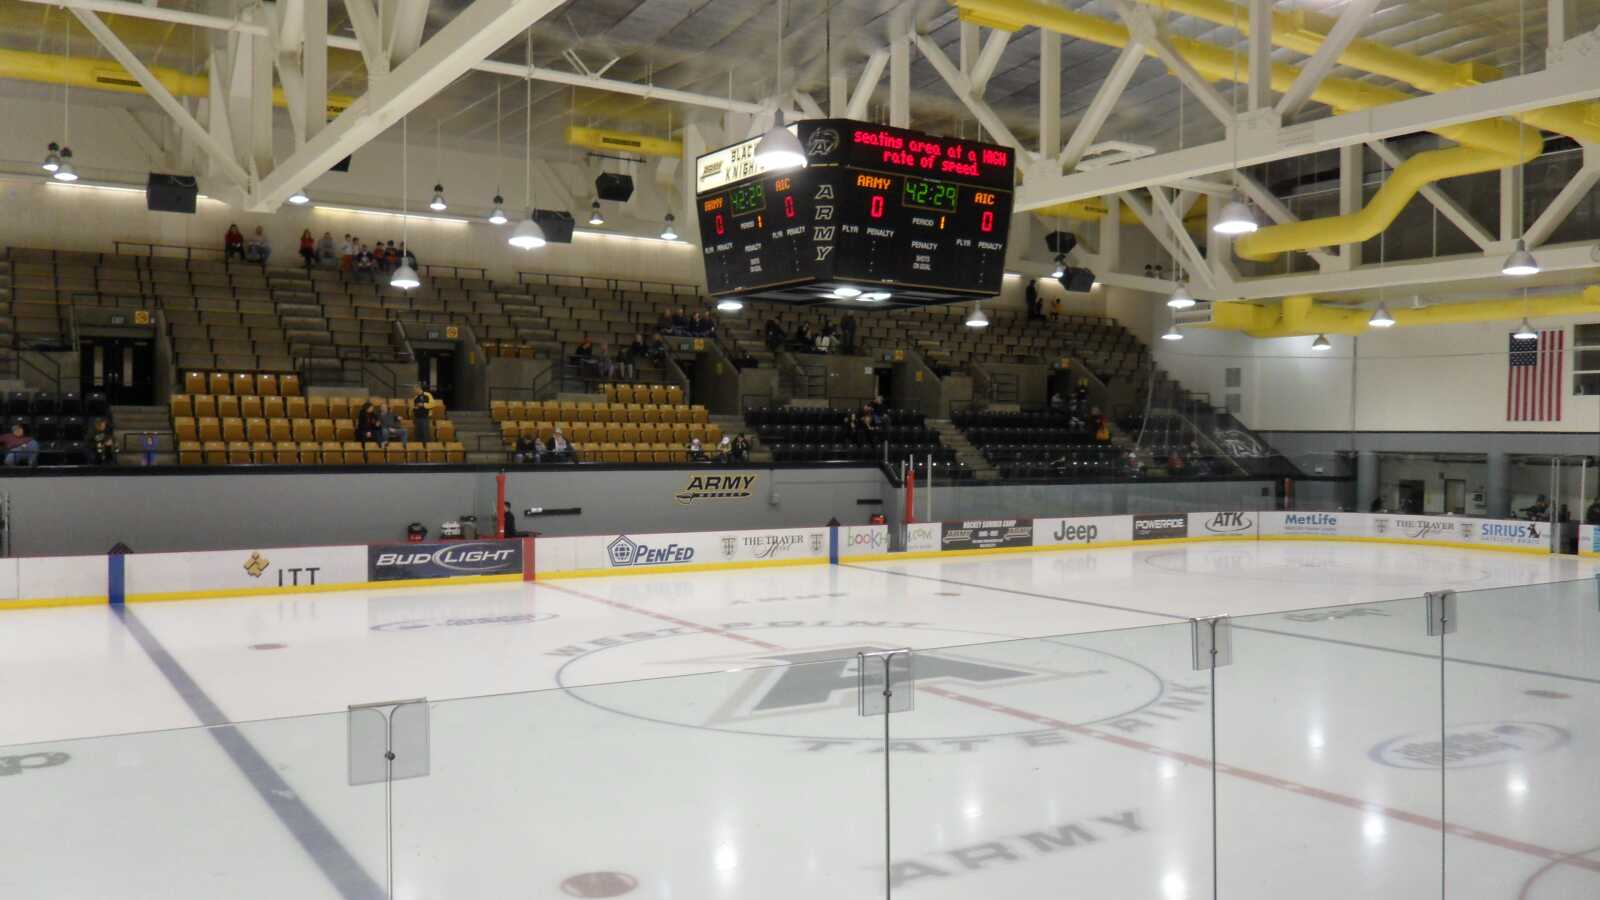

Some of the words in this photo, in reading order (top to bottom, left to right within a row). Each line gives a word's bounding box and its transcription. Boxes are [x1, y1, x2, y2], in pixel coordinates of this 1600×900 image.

[731, 145, 753, 162] BLAC
[883, 150, 914, 167] rate
[919, 155, 935, 169] of
[908, 140, 941, 156] area
[947, 144, 962, 160] at
[968, 150, 977, 162] a
[856, 174, 891, 190] ARMY
[905, 181, 956, 207] 42:29
[974, 192, 995, 205] AIC
[785, 196, 795, 218] 0
[871, 195, 884, 218] 0
[715, 213, 725, 236] 0
[911, 216, 934, 227] PERIOD
[939, 216, 945, 229] 1
[981, 211, 993, 231] 0
[866, 226, 895, 239] PENALTY
[911, 240, 938, 251] PENALTY
[977, 240, 1003, 252] PENALTY
[687, 475, 756, 491] ARMY
[1135, 518, 1185, 531] POWERADE
[1212, 511, 1243, 528] ATK
[1285, 514, 1337, 526] MetLife
[1396, 519, 1418, 529] THE
[1054, 521, 1097, 542] Jeep
[1481, 523, 1526, 538] SIRIUS
[743, 536, 764, 546] THE
[376, 552, 430, 566] BUD
[444, 549, 514, 564] LIGHT
[278, 567, 321, 587] ITT
[792, 729, 1074, 753] TATE
[870, 809, 1146, 888] ARMY
